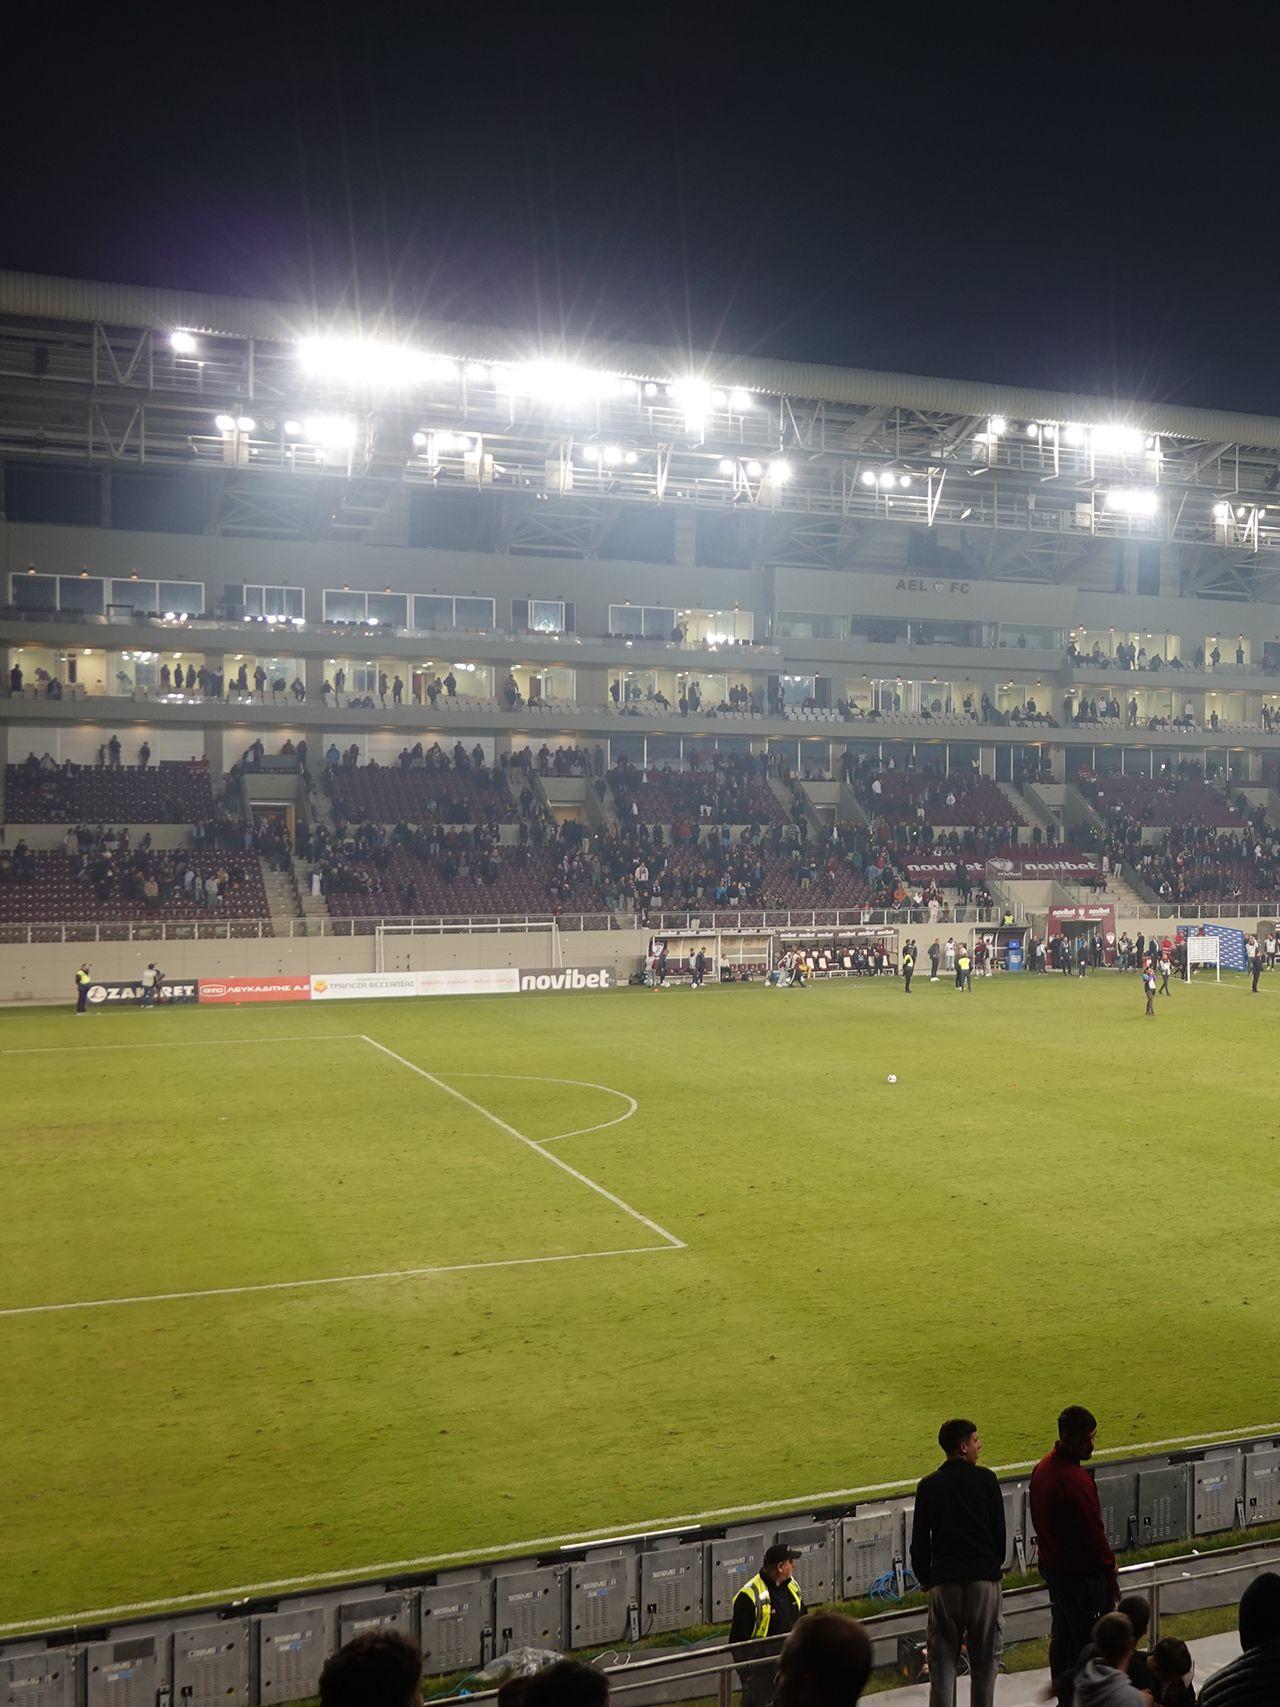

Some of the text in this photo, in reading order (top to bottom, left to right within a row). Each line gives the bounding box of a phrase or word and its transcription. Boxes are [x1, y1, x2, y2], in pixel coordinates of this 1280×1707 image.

[896, 579, 970, 594] AEL FC
[521, 968, 609, 990] novibet
